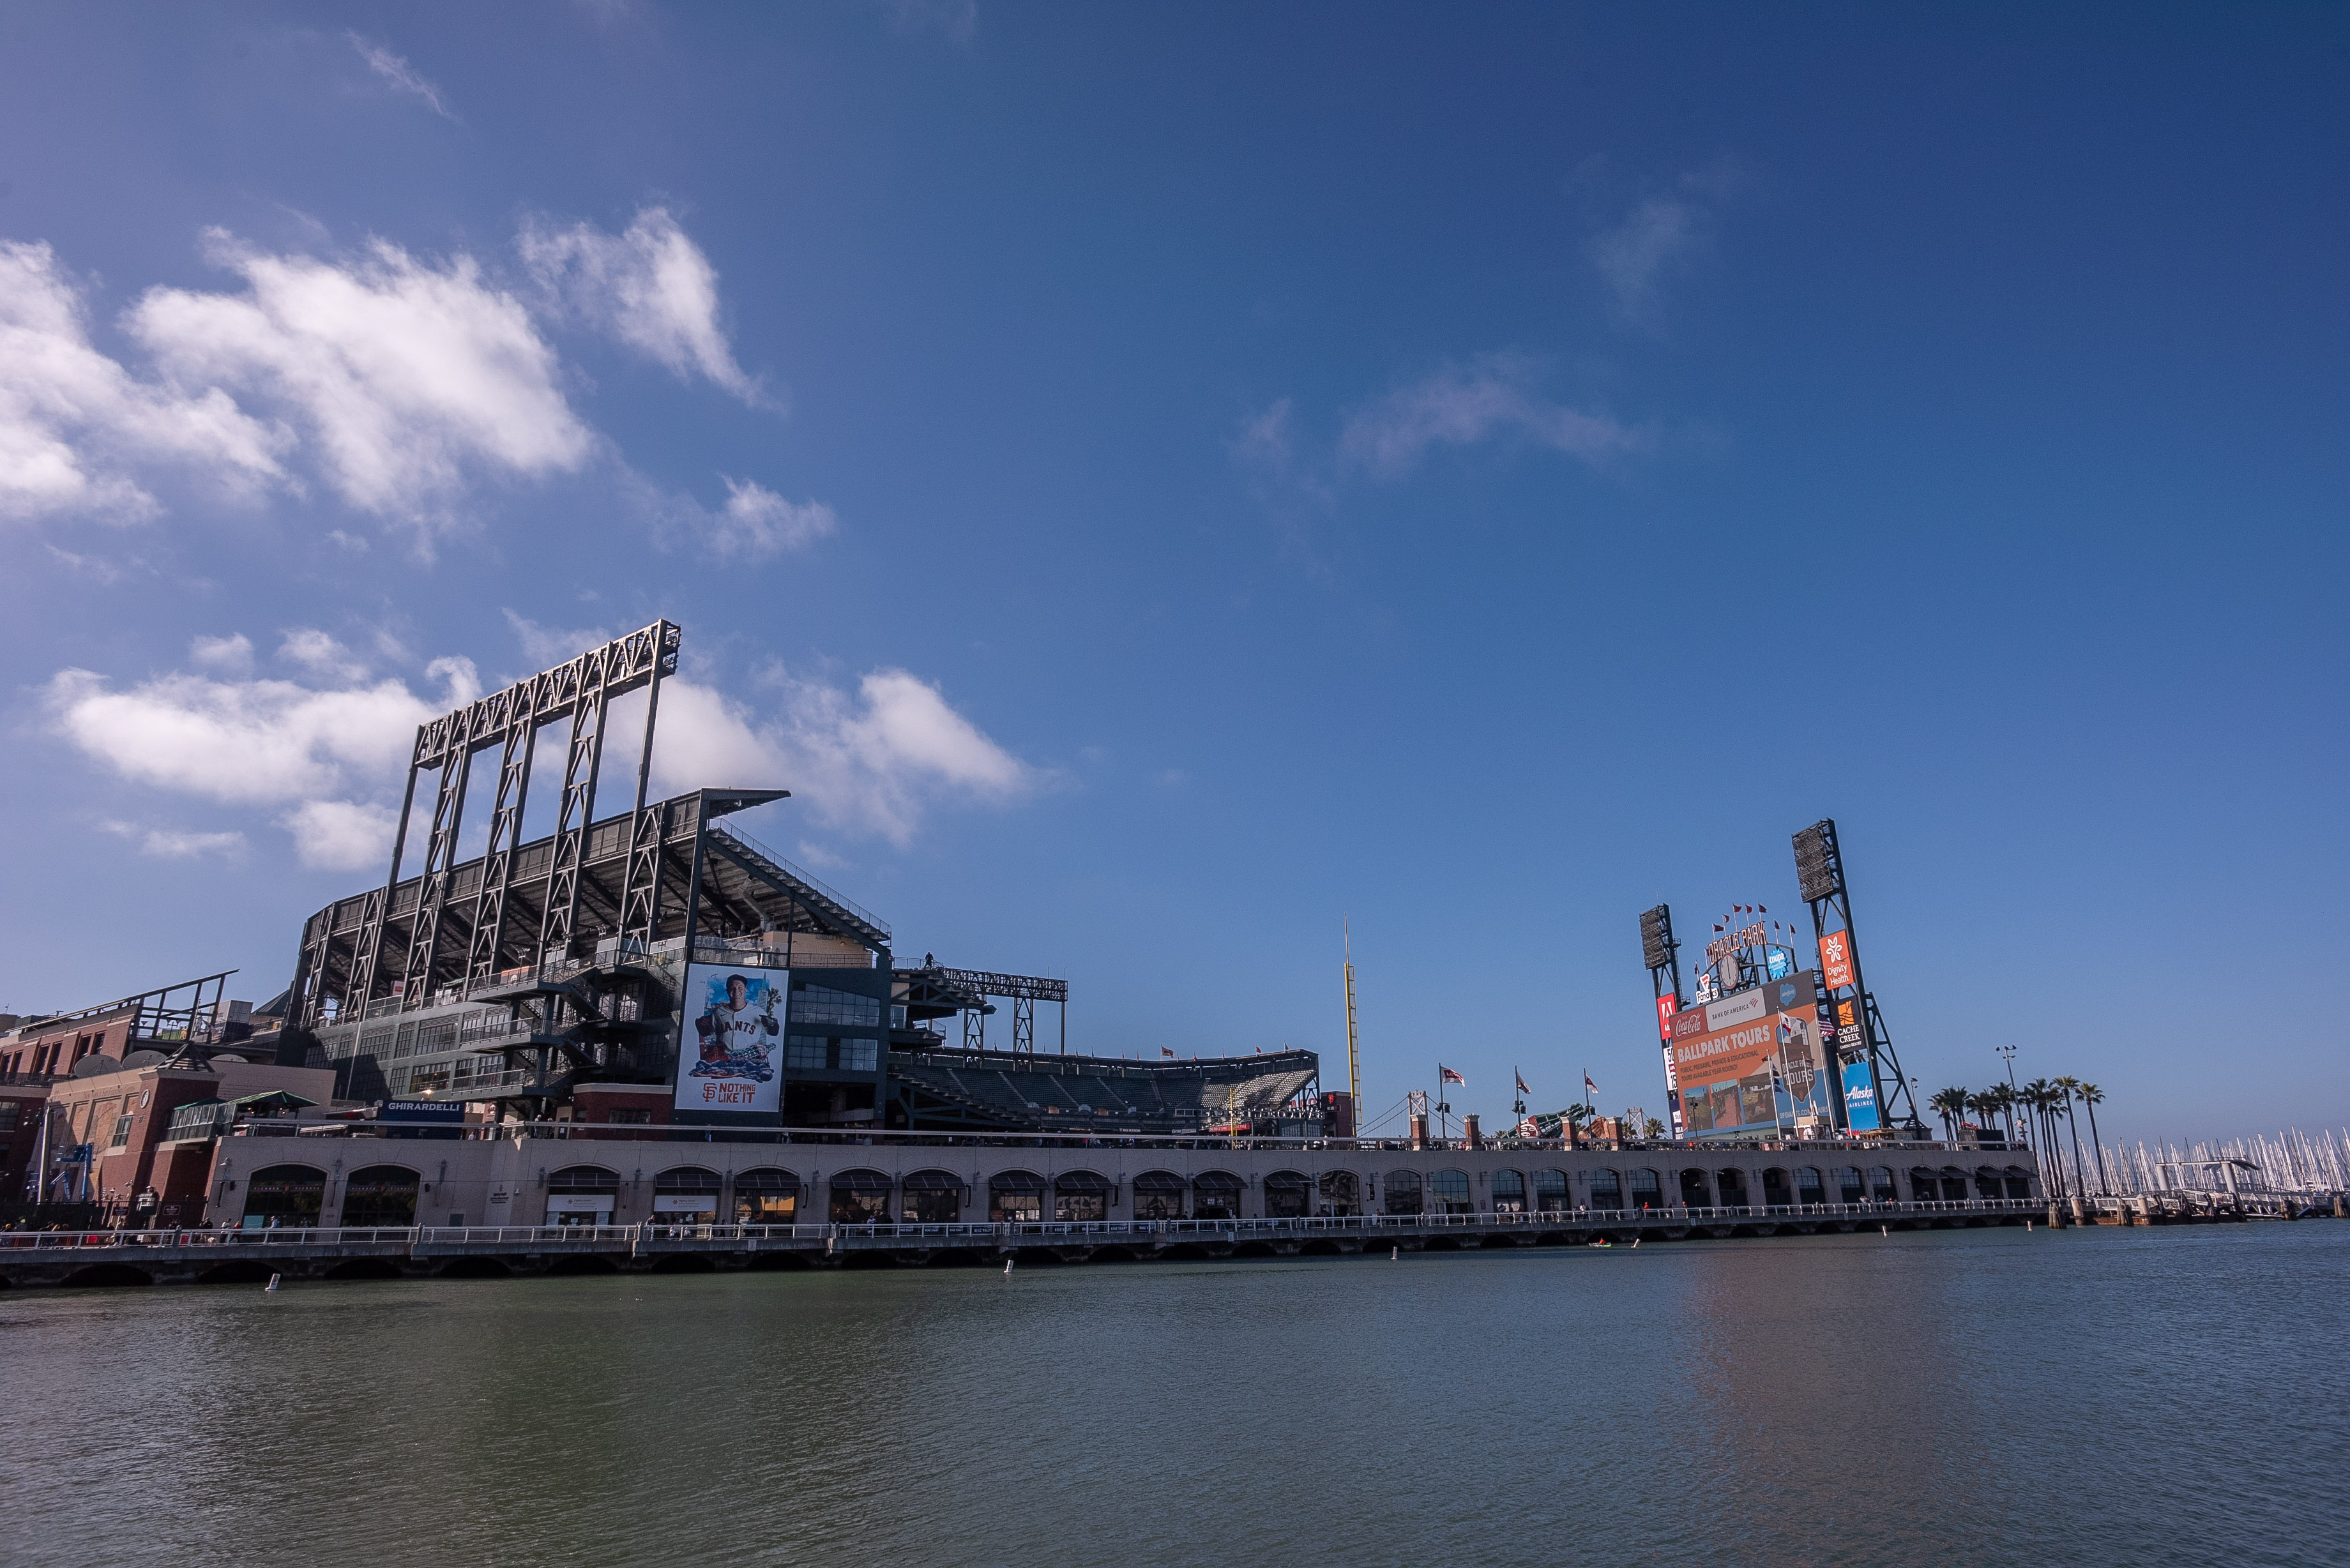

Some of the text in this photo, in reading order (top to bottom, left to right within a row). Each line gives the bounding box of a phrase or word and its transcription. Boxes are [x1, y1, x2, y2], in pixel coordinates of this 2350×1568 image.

[1708, 921, 1768, 965] ORACLE PARK
[1769, 953, 1785, 964] coupa
[1828, 963, 1847, 976] Dignity
[1830, 974, 1849, 986] Health
[1697, 989, 1718, 1002] Fanacs
[1712, 1012, 1724, 1020] BANK
[1730, 1004, 1749, 1014] AMERICA
[721, 1020, 756, 1035] ANTS
[1837, 1025, 1860, 1036] CACHE
[1677, 1024, 1771, 1064] BALLPARK TOURS
[1839, 1033, 1861, 1044] CREEK
[1680, 1066, 1693, 1074] PUBLIC,
[1693, 1062, 1711, 1071] PREGAME,
[1711, 1057, 1727, 1067] PRIVATE
[1731, 1050, 1759, 1061] EDUCATIONAL
[1799, 1059, 1813, 1069] PA
[1693, 1070, 1712, 1079] AVAILABLE
[1712, 1064, 1738, 1076] YEAR-ROUND!
[1783, 1069, 1814, 1085] TOURS
[719, 1083, 756, 1093] NOTHING
[1846, 1085, 1874, 1101] Alaska
[718, 1092, 755, 1103] LIKE IT
[388, 1103, 460, 1112] GHIRARDELLI
